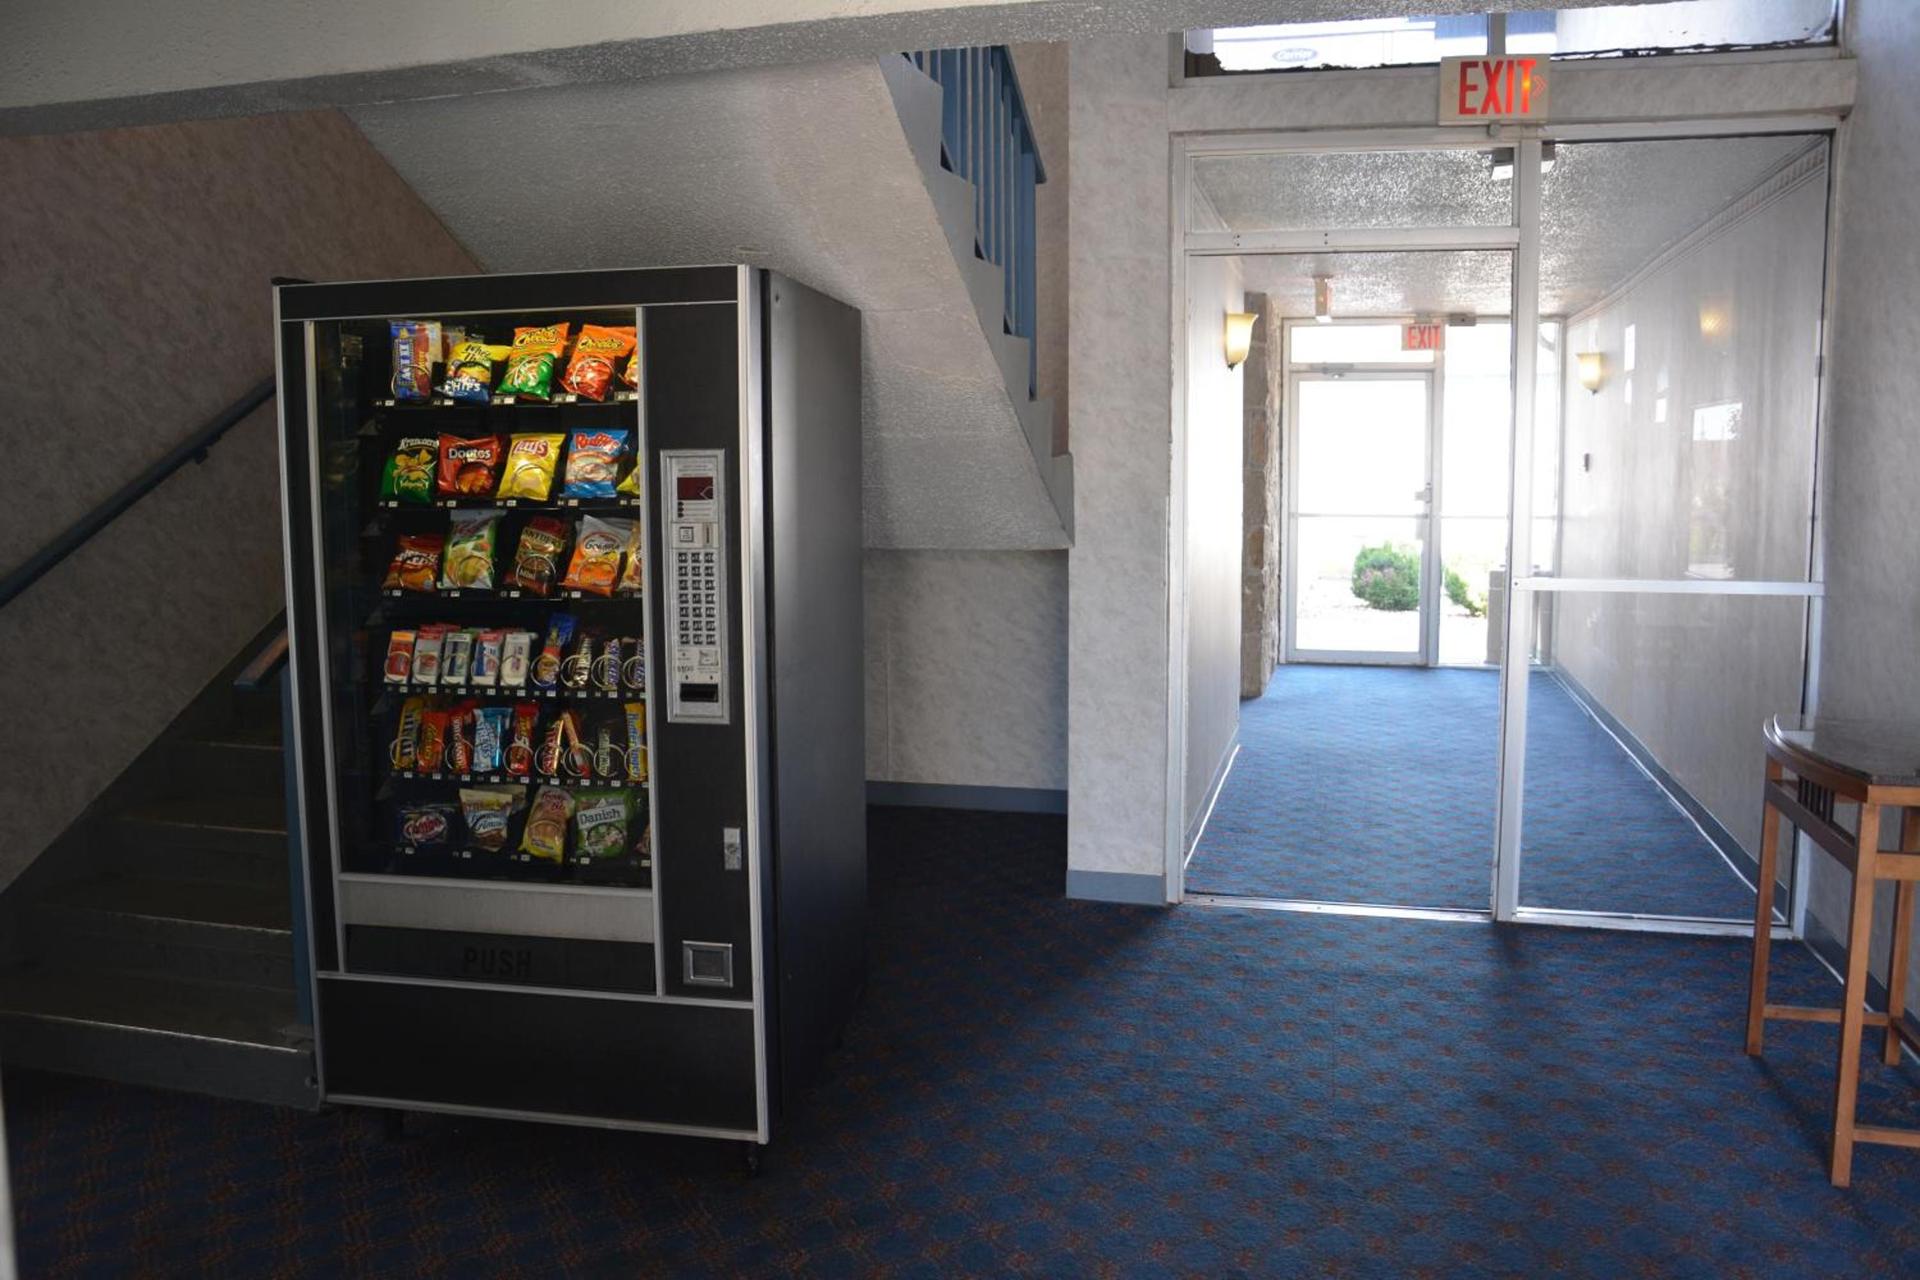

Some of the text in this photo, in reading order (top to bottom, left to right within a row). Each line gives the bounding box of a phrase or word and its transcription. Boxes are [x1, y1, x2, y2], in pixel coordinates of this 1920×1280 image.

[1459, 58, 1537, 115] EXIT
[1407, 325, 1441, 350] EXIT
[450, 447, 496, 461] Doritos
[578, 808, 622, 825] Danish
[463, 947, 532, 977] PUSH
